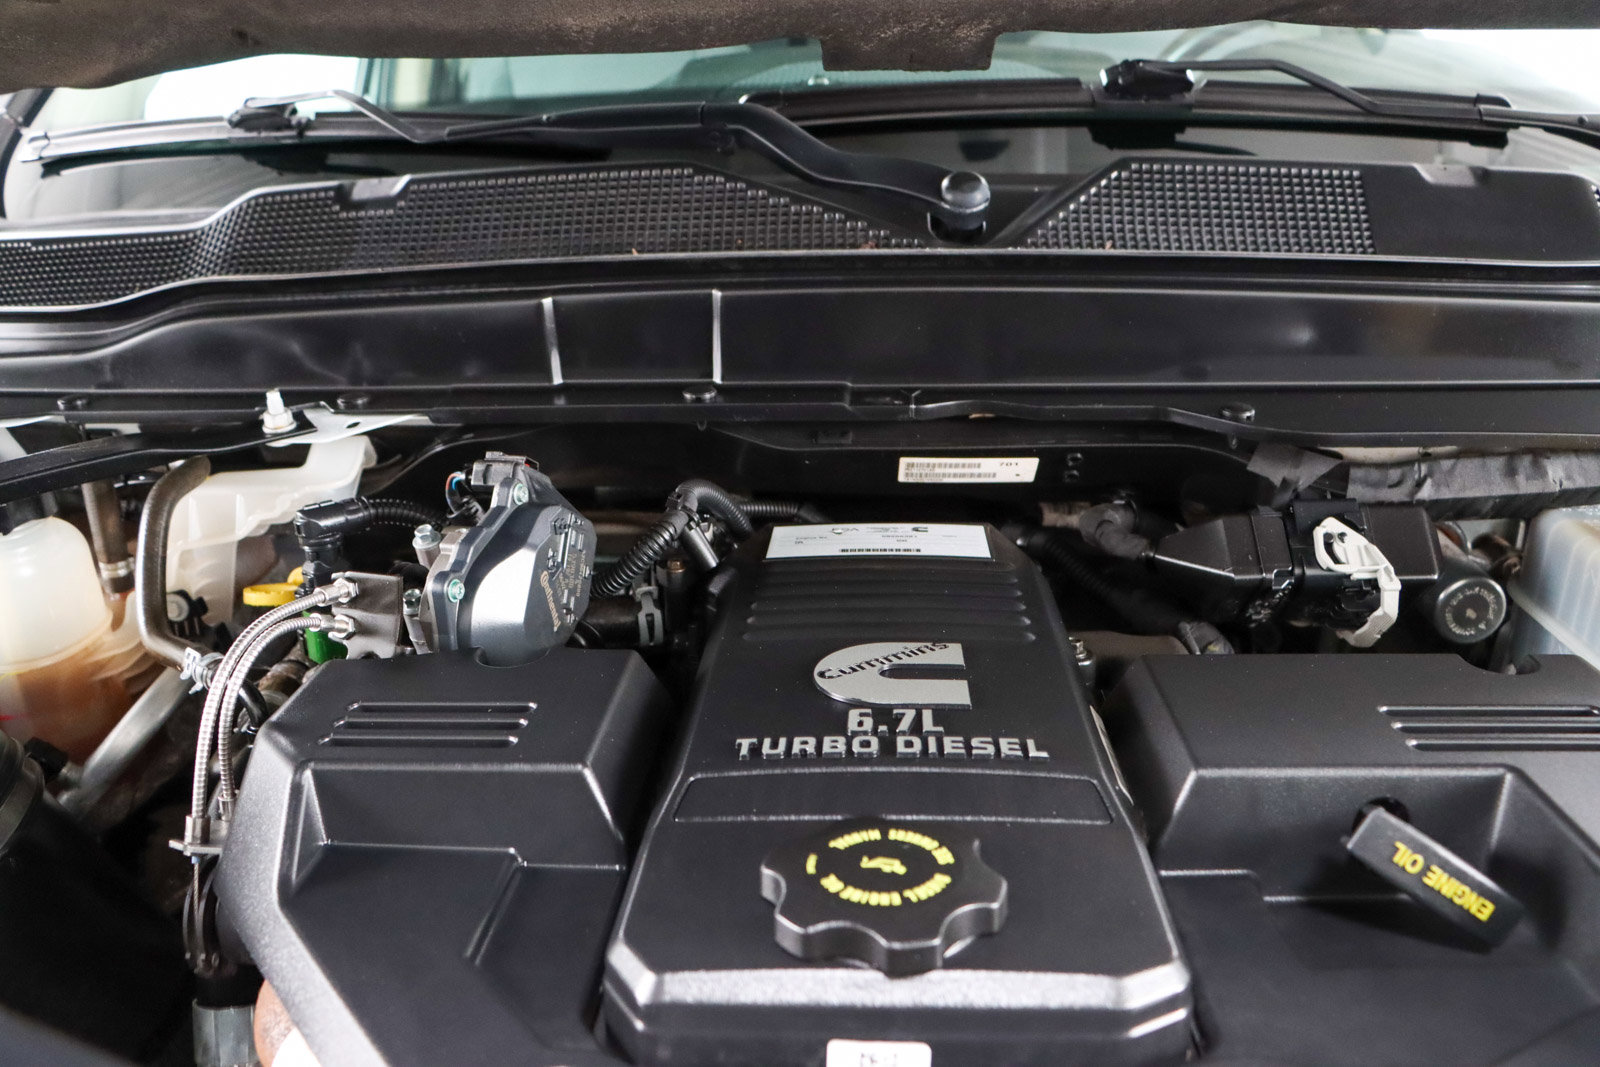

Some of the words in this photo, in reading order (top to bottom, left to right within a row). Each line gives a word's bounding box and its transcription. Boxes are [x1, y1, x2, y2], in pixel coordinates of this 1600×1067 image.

[540, 571, 561, 630] Continental
[817, 641, 950, 679] Cummins
[847, 708, 945, 736] 6.7L
[735, 735, 880, 761] TURBO
[896, 735, 1050, 761] DIESEL
[1392, 840, 1425, 875] OIL
[838, 885, 902, 906] ENGINE
[1421, 864, 1496, 922] ENGINE
